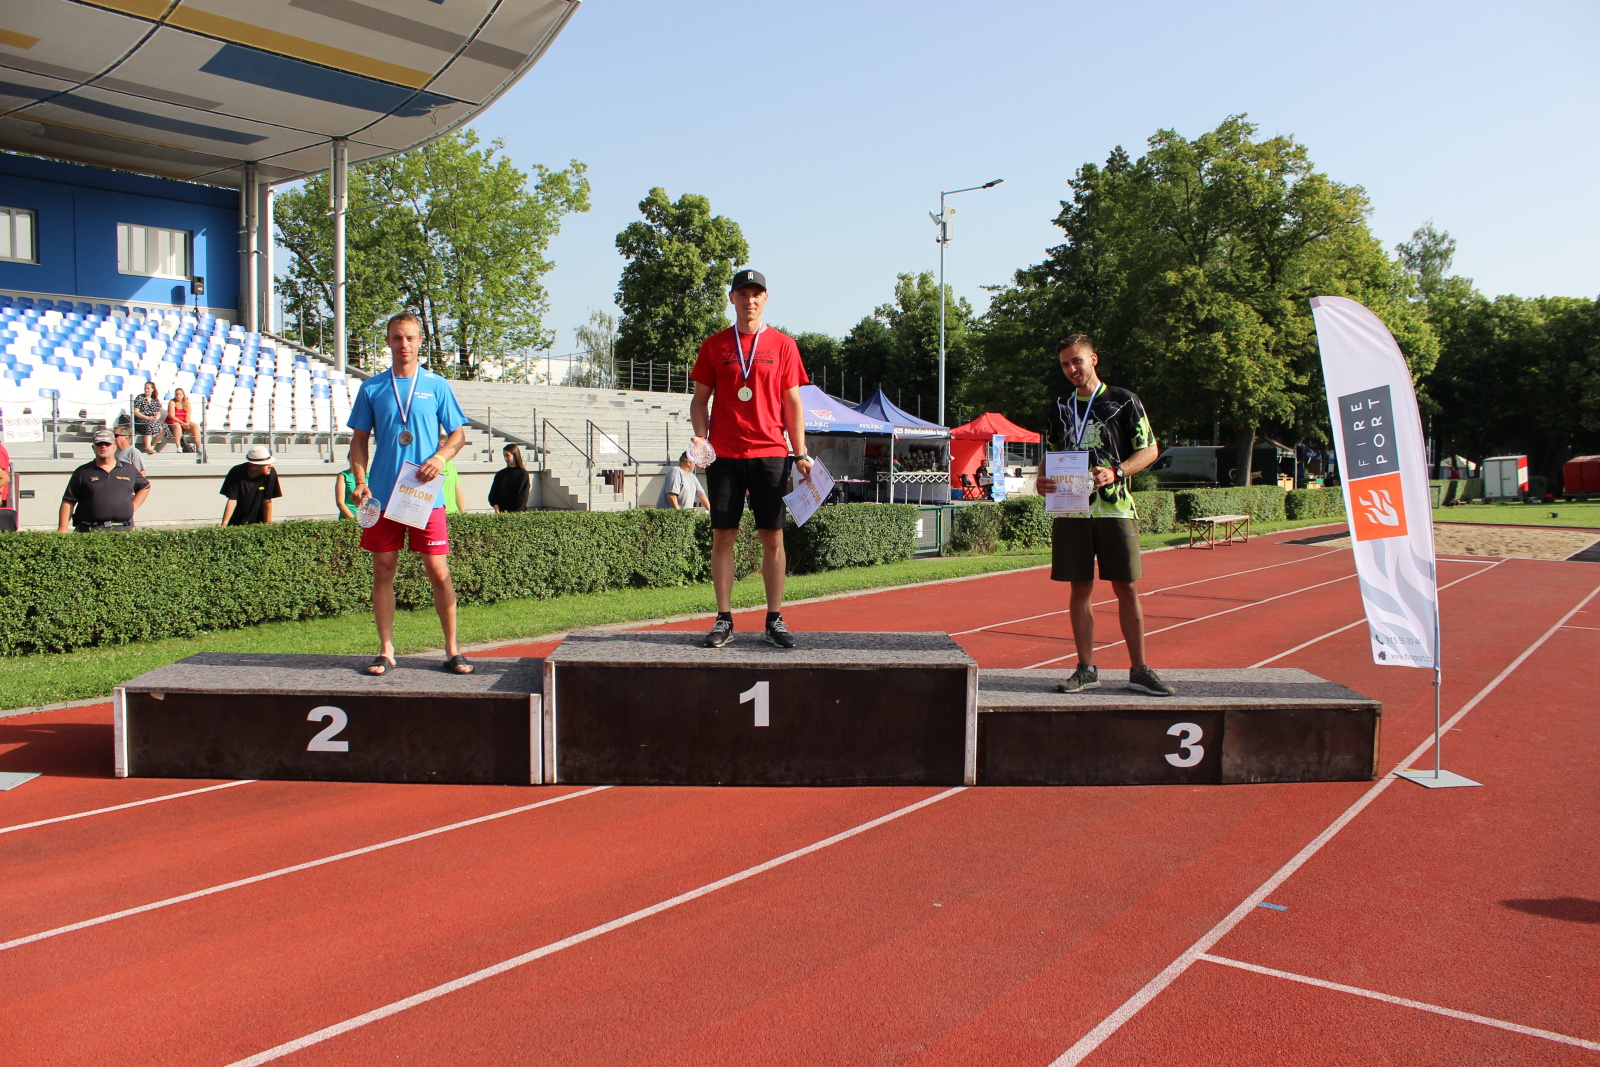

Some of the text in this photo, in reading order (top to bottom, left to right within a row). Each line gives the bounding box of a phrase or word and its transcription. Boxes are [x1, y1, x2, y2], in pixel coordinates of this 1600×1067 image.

[1350, 402, 1369, 467] FIRE
[1367, 398, 1388, 465] PORT
[399, 484, 433, 502] DIPLOM
[1050, 475, 1083, 484] DIPLO
[1385, 636, 1398, 645] 315
[739, 681, 770, 727] 1
[306, 705, 349, 752] 2
[1164, 722, 1205, 768] 3
